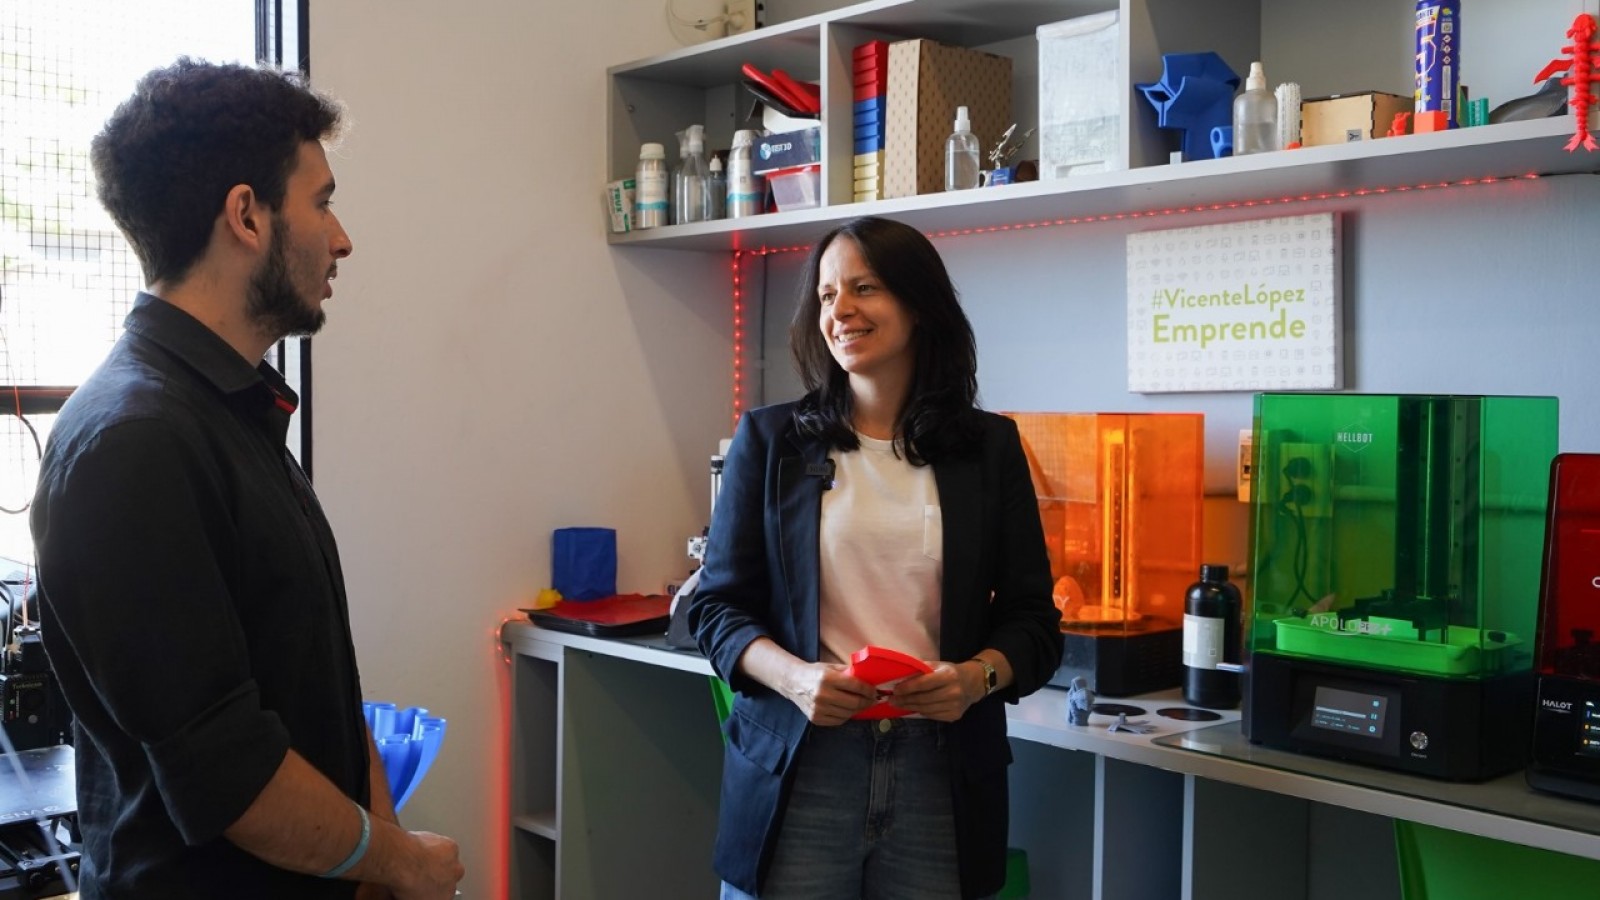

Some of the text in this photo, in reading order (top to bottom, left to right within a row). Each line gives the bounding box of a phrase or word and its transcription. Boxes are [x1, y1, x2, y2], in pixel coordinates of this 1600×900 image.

[1151, 283, 1305, 312] #VicenteLópez
[1153, 308, 1306, 349] Emprende
[1336, 432, 1373, 443] HELLBOT
[1310, 615, 1358, 633] APOLO
[1542, 699, 1574, 710] HALOT
